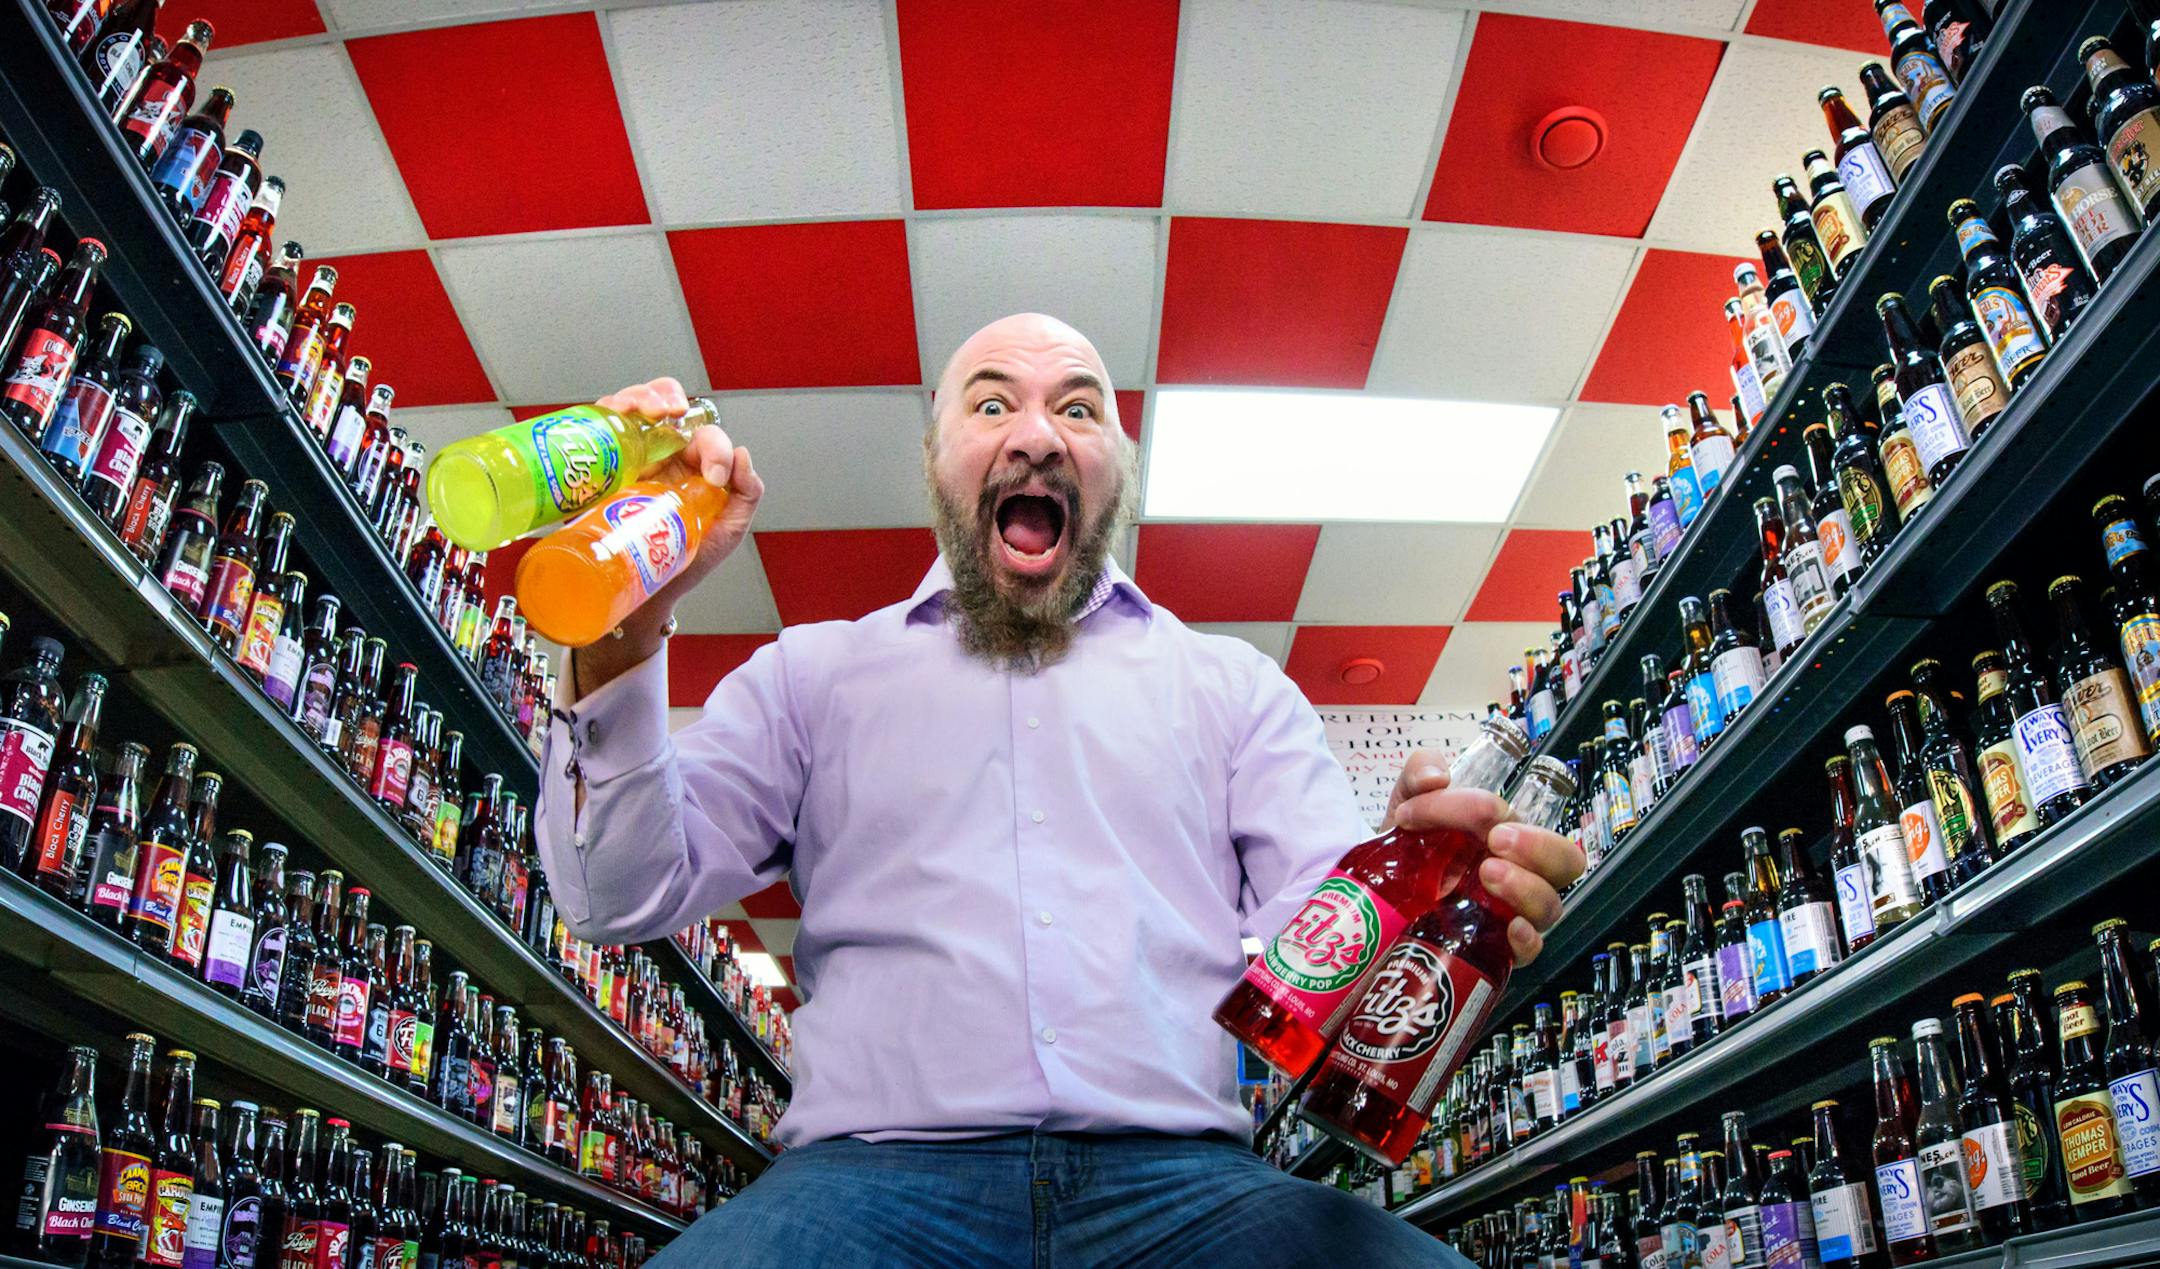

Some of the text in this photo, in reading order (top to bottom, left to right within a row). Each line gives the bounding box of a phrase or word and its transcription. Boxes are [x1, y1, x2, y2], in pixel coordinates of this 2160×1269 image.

[126, 485, 152, 534] Black Cherry
[1321, 711, 1477, 724] REEDOM
[44, 799, 70, 860] Black Cherry
[97, 887, 122, 902] Black
[1278, 898, 1368, 972] Fitz's
[1386, 958, 1430, 986] PREMIUM
[1308, 979, 1333, 990] POP
[1304, 1006, 1316, 1019] MO
[1351, 970, 1437, 1038] Fitz's
[2063, 1017, 2085, 1033] Beer
[1355, 1042, 1401, 1060] CHERRY
[1385, 1078, 1399, 1091] MO
[2064, 1124, 2105, 1150] THOMAS
[2068, 1138, 2109, 1164] KEMPER
[2071, 1167, 2088, 1182] Root
[2088, 1160, 2110, 1176] Beer
[48, 1214, 80, 1229] Black
[107, 1213, 132, 1229] Black
[1643, 1251, 1666, 1269] Cola
[1705, 1242, 1727, 1266] COLA
